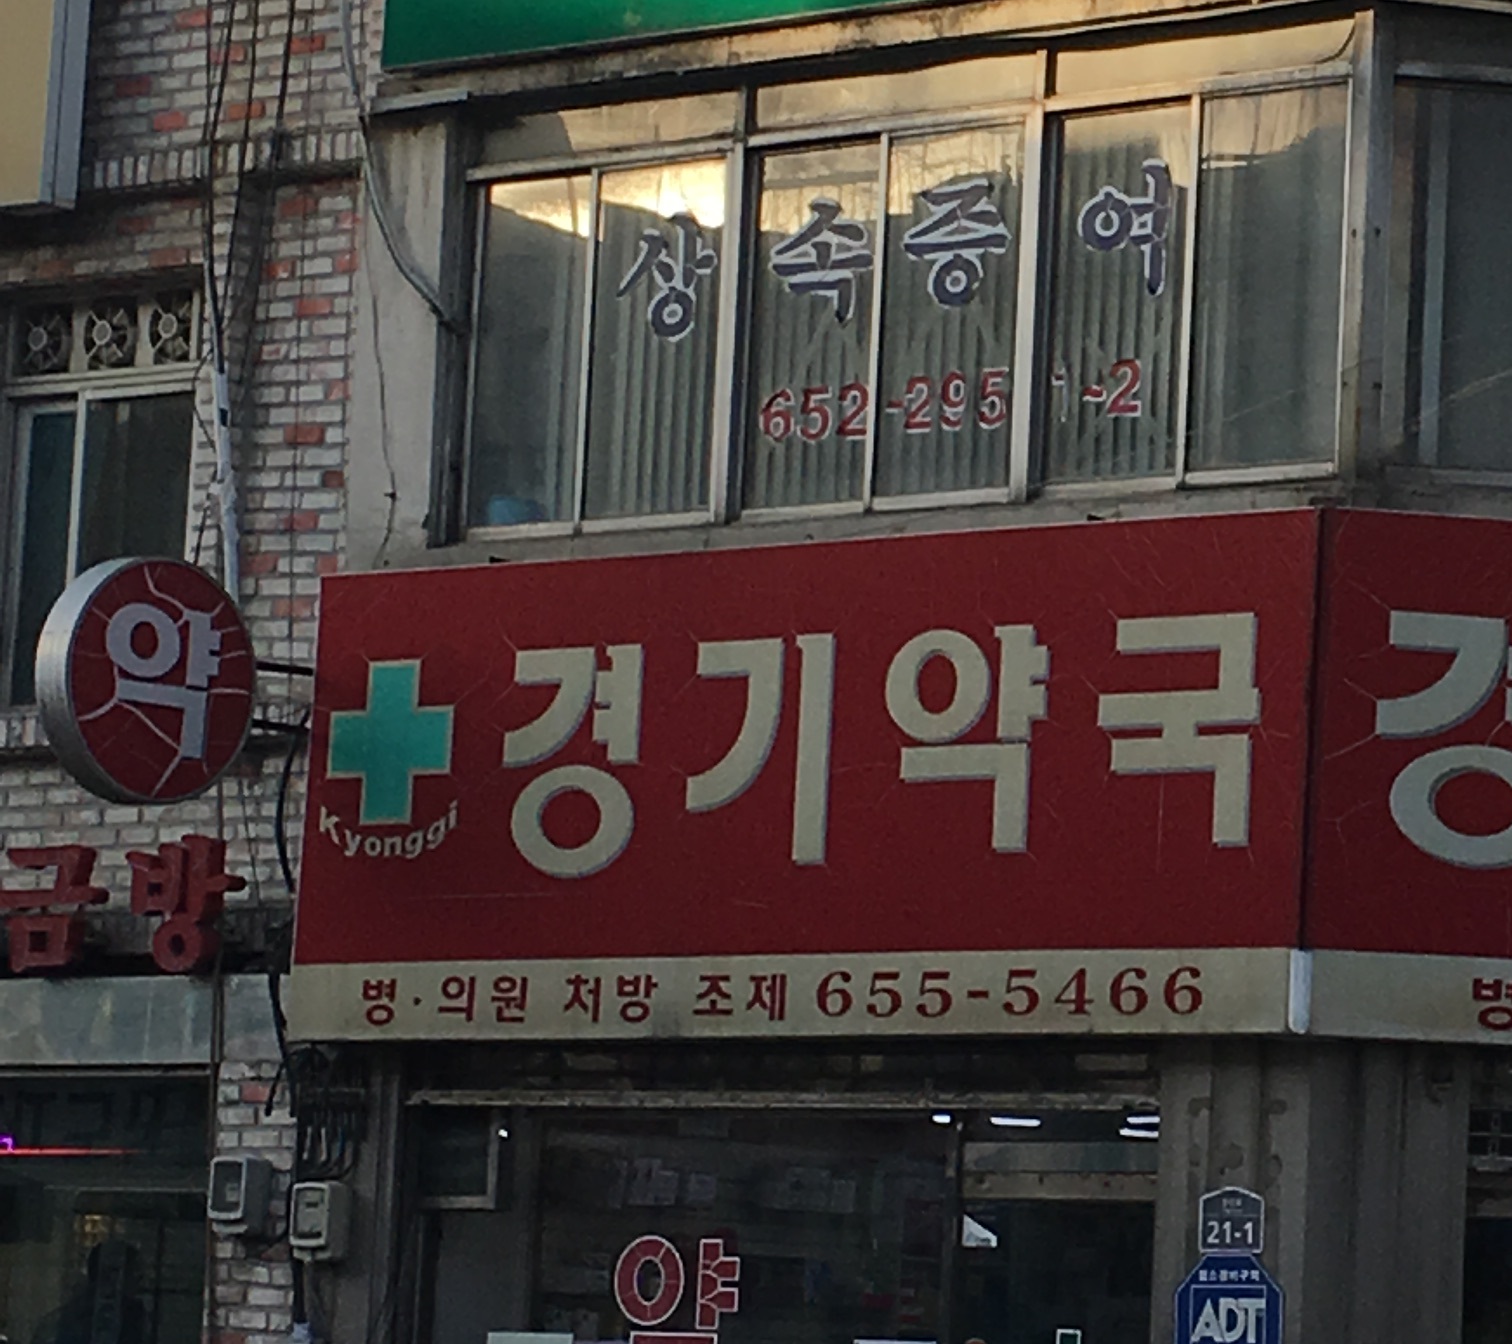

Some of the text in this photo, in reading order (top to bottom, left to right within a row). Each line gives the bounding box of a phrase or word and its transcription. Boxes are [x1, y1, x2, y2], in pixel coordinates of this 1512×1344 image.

[105, 601, 222, 760] 약
[500, 611, 1263, 880] 경기약국
[318, 801, 459, 859] Kyonggi
[564, 971, 659, 1024] 처방
[693, 969, 787, 1024] 조제
[813, 964, 1205, 1023] 655-5466
[1206, 1220, 1254, 1245] 21-1
[1191, 1296, 1267, 1344] ADT
